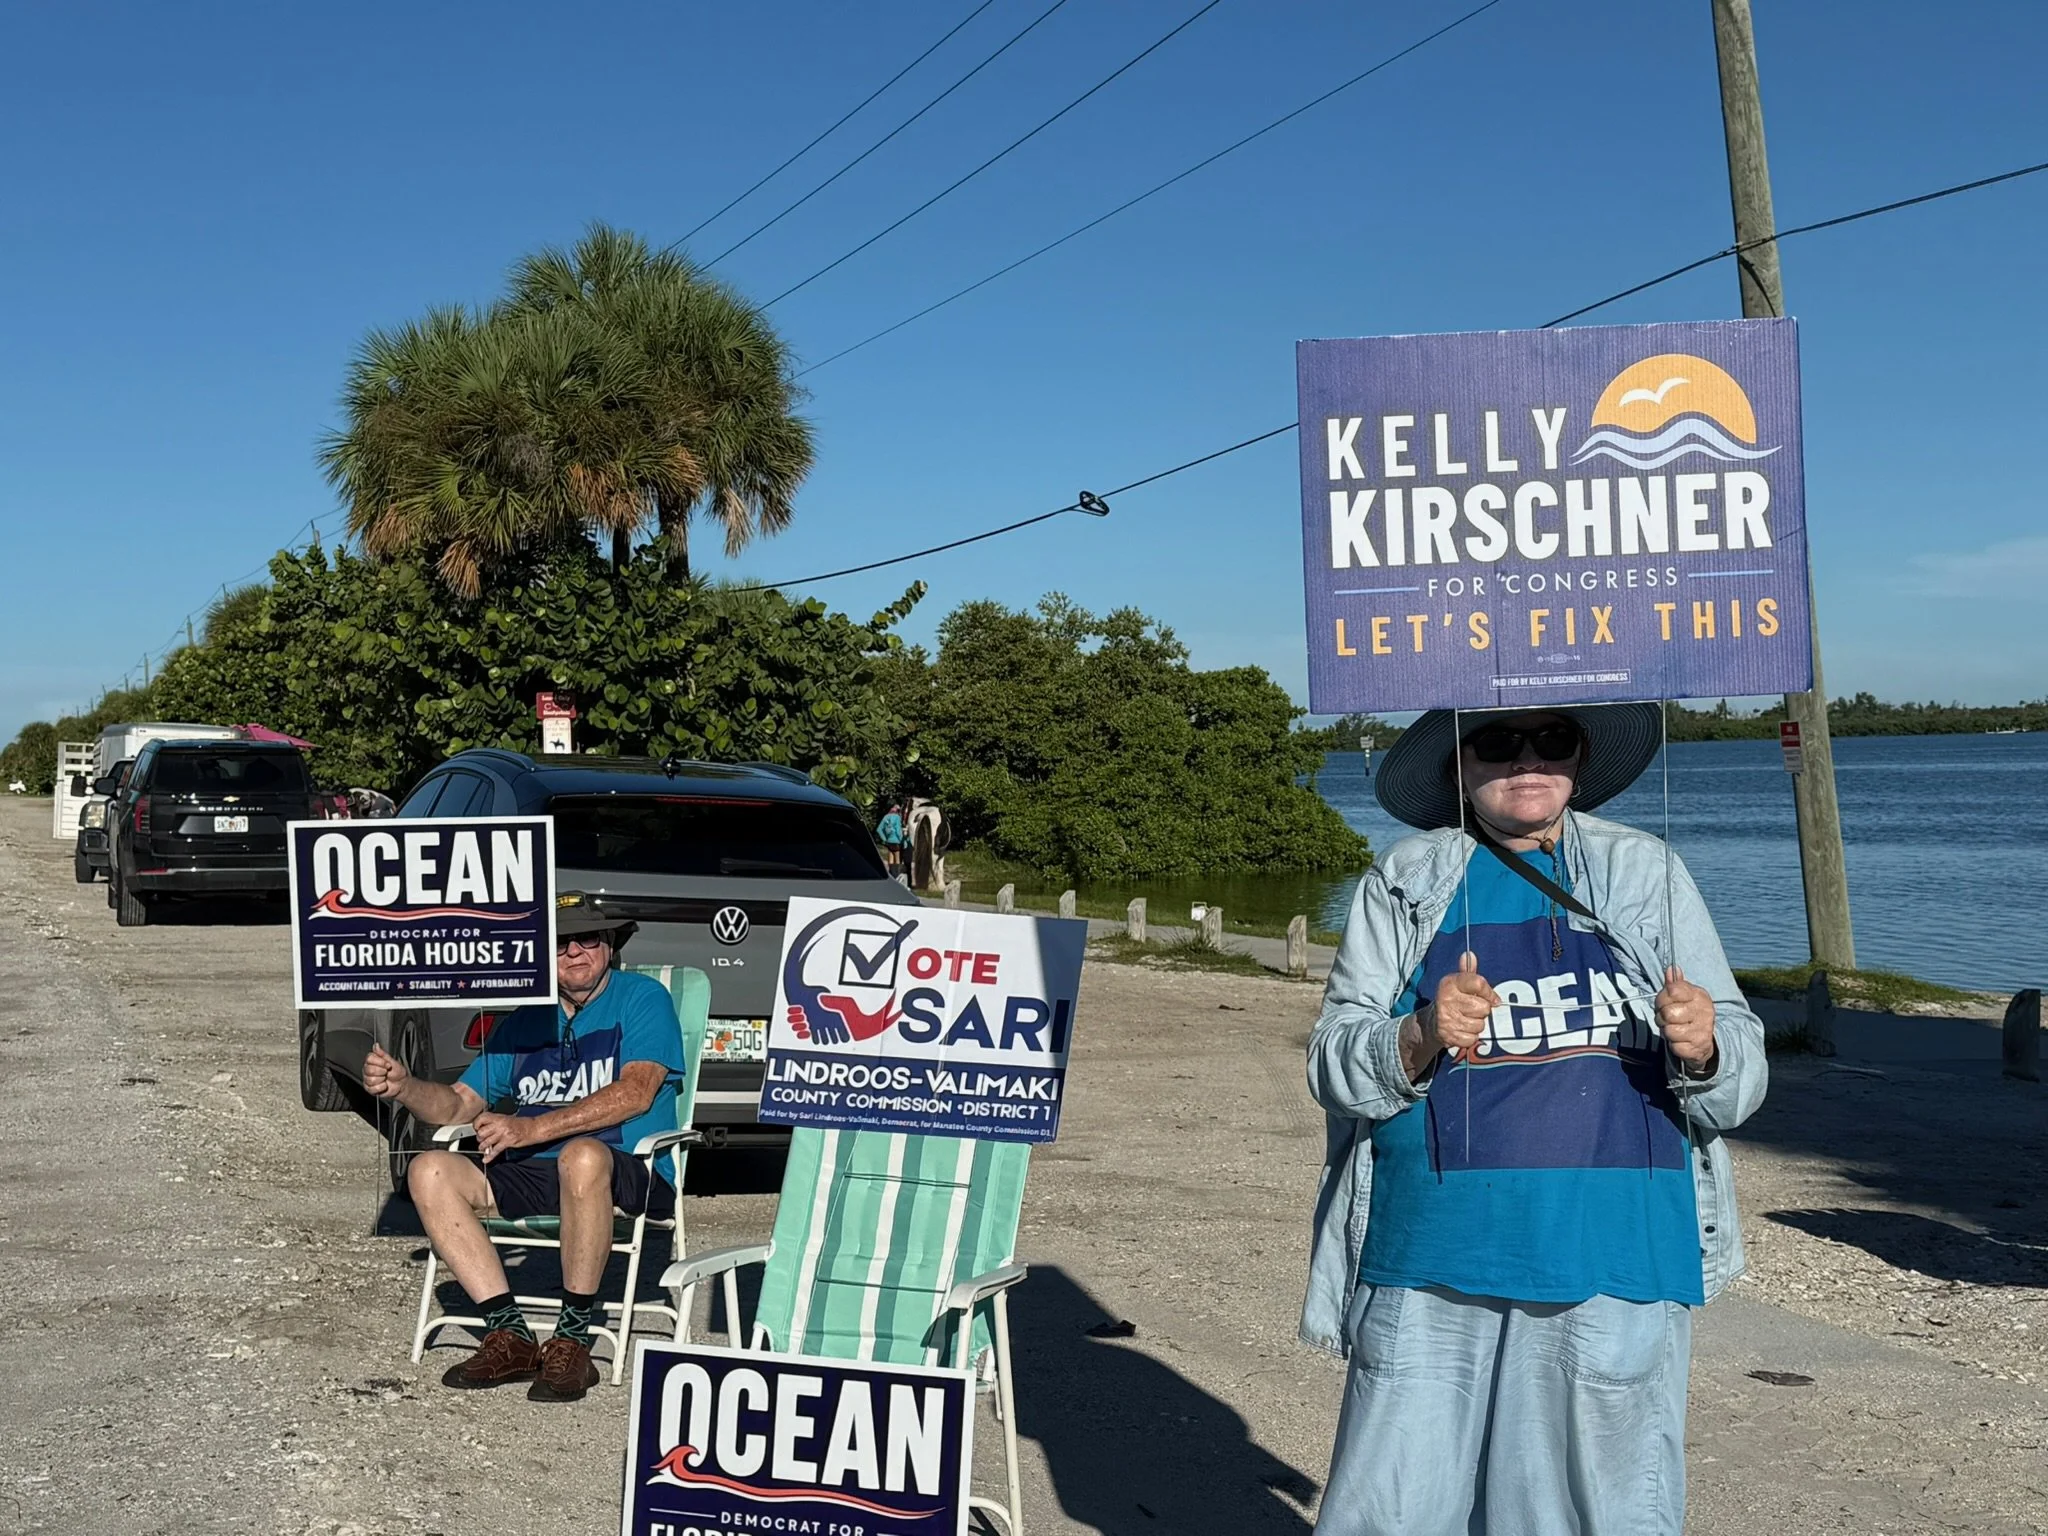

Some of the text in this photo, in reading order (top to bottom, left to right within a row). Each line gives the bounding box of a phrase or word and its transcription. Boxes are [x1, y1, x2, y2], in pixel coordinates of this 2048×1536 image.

[1326, 407, 1567, 480] KELLY
[1328, 471, 1773, 569] KIRSCHNER
[1428, 567, 1677, 597] FOR CONGRESS
[1336, 598, 1779, 656] LET'S FIX THIS
[1529, 676, 1547, 685] KELLY
[313, 830, 534, 906] OCEAN
[315, 940, 534, 967] FLORIDA HOUSE 71
[370, 928, 481, 939] DEMOCRAT FOR
[318, 978, 535, 991] ACCOUNTABILITY STABILITY AFFORDABILITY
[897, 987, 1071, 1053] SARI
[1449, 967, 1662, 1056] CEAN
[517, 1057, 614, 1105] OCEAN
[766, 1057, 1059, 1101] LINDROOS-VALIMAKI
[760, 1108, 776, 1117] Paid
[776, 1109, 788, 1118] for
[788, 1111, 798, 1120] by
[920, 1120, 932, 1129] for
[933, 1121, 965, 1131] Manatee
[965, 1123, 993, 1134] County
[993, 1126, 1040, 1136] Commission
[771, 1087, 1051, 1121] COUNTY COMMISSION DISTRICT 1
[659, 1362, 945, 1496] OCEAN
[720, 1511, 821, 1534] DEMOCRAT
[829, 1523, 864, 1536] FOR
